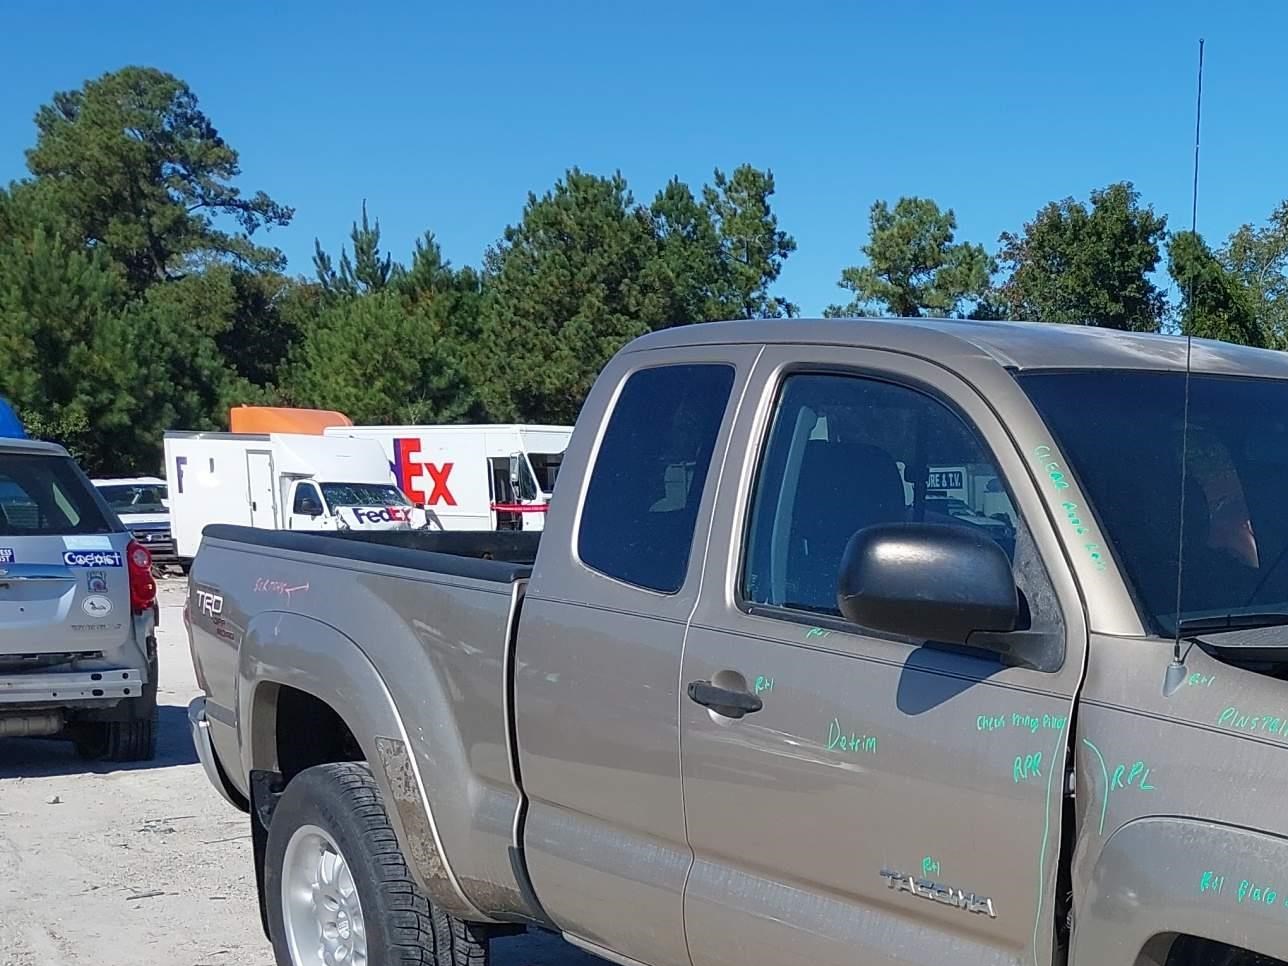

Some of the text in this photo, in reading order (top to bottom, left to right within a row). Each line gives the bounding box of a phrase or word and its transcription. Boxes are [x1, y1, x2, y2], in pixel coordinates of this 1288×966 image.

[352, 507, 411, 524] FedEx
[196, 590, 223, 617] TRD
[826, 717, 877, 753] Detrim
[1111, 761, 1155, 791] RPL
[880, 869, 997, 919] TACOMA
